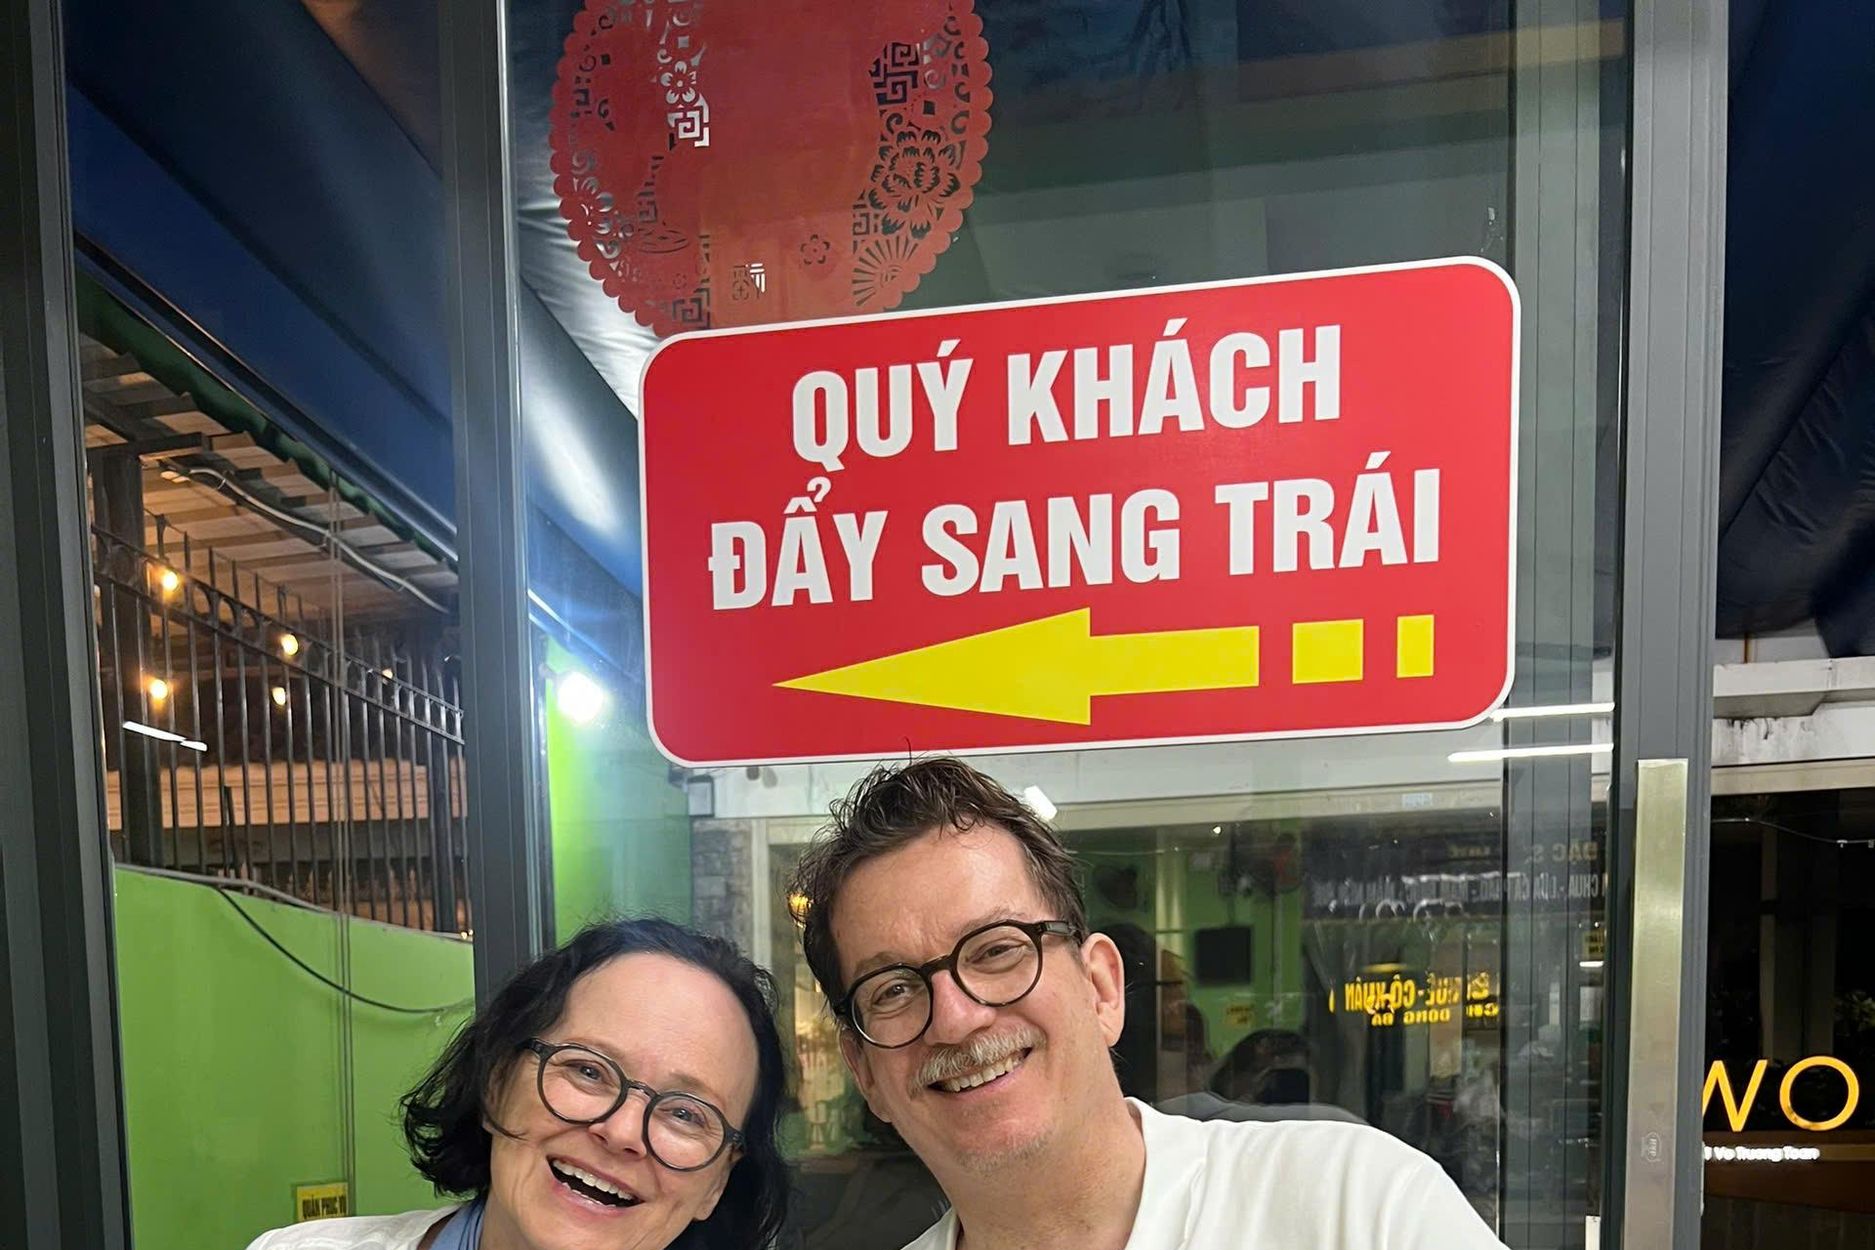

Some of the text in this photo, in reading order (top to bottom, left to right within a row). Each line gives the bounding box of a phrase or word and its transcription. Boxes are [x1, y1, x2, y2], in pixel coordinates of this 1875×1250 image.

[792, 317, 1341, 472] QUÝ KHÁCH
[708, 450, 1441, 610] ĐẨY SANG TRÁI
